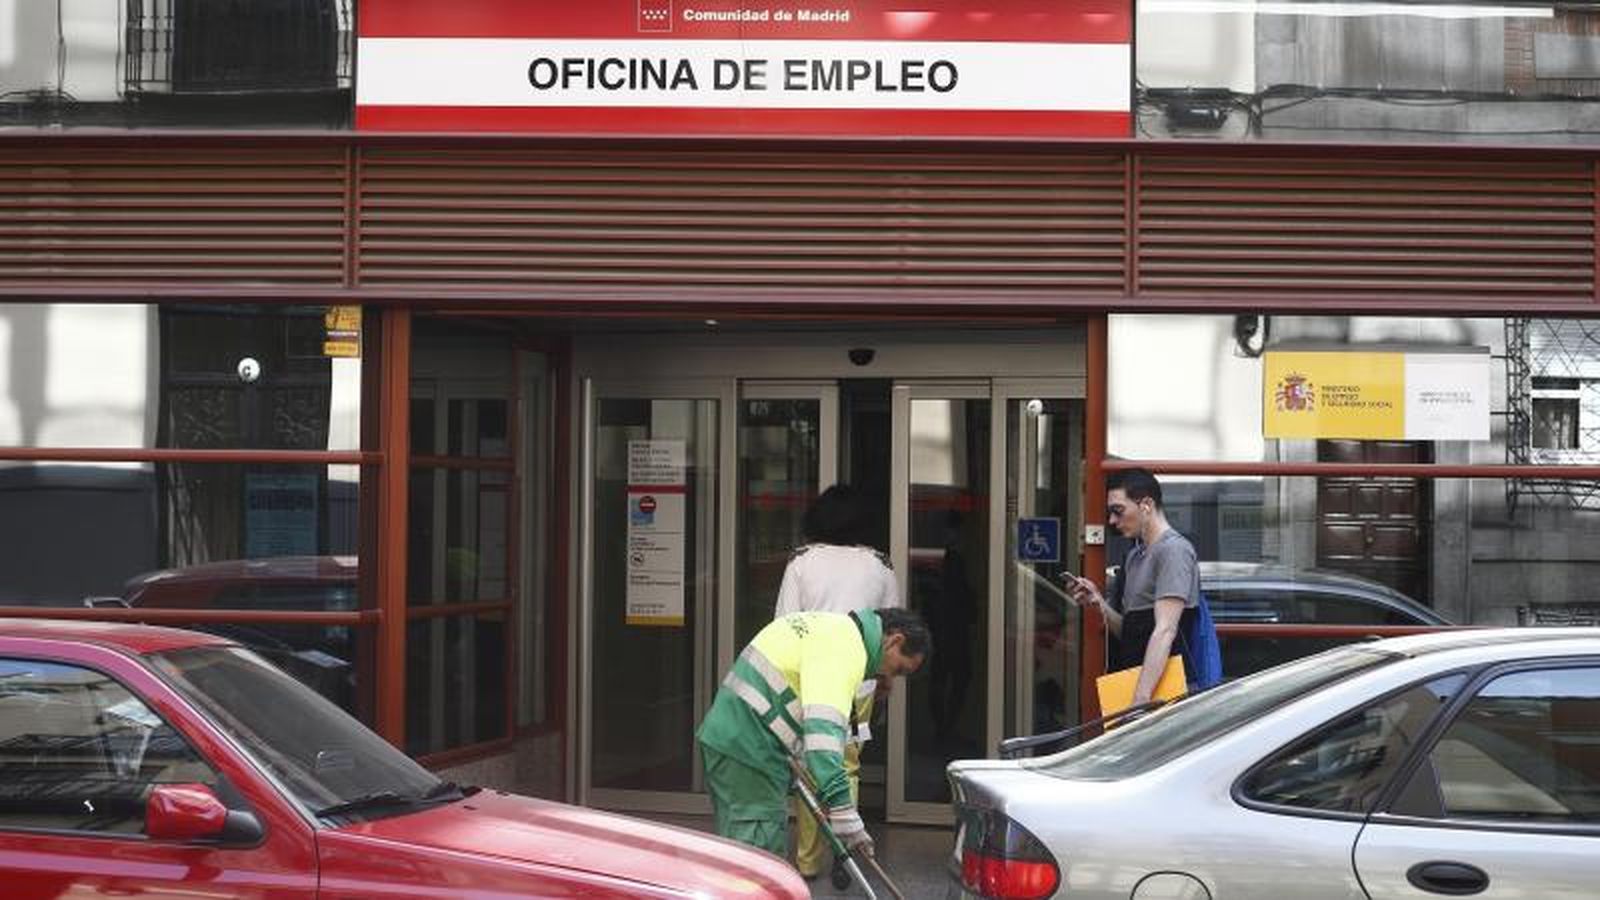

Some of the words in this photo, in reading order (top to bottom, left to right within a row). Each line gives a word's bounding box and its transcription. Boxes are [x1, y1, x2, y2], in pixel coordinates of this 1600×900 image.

[683, 9, 769, 22] Comunidad
[773, 9, 793, 22] de
[797, 9, 850, 22] Madrid
[527, 57, 698, 91] OFICINA
[713, 59, 768, 91] DE
[783, 59, 959, 93] EMPLEO
